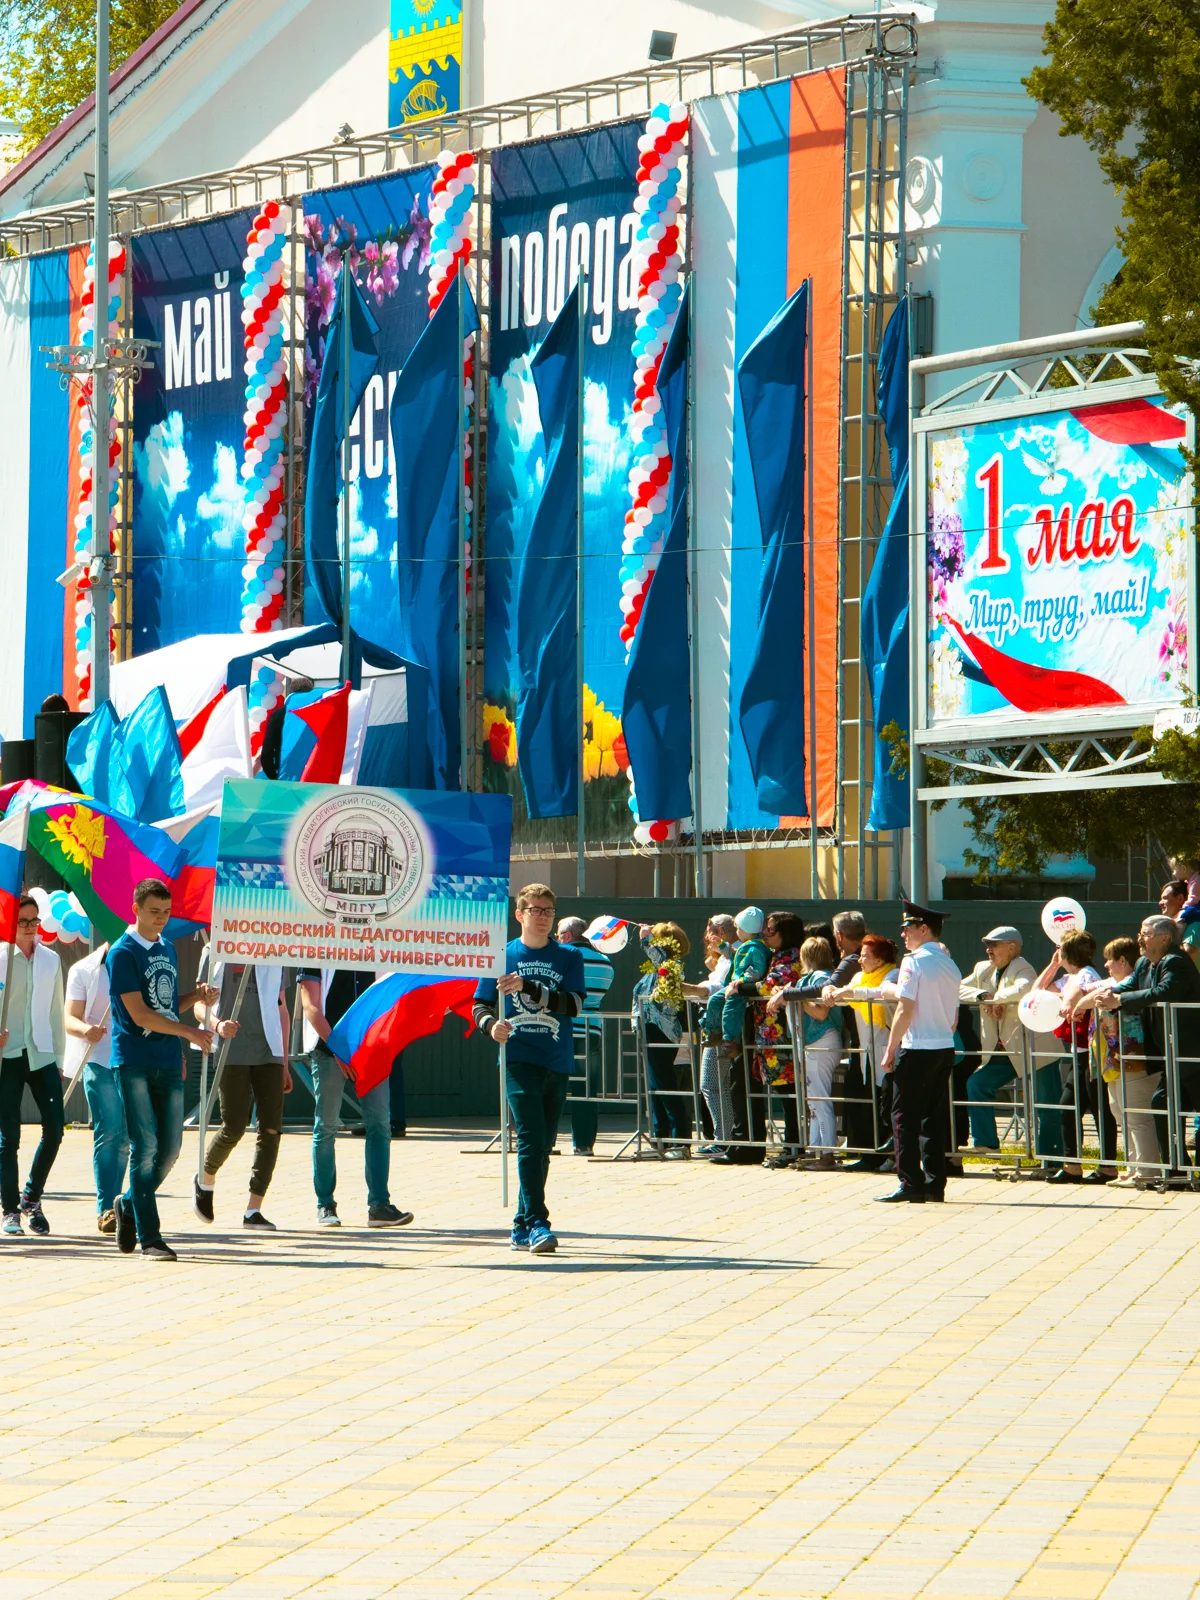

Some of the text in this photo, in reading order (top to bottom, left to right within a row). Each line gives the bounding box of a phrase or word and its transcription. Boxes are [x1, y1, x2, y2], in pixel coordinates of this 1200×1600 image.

[164, 270, 232, 391] май
[979, 459, 1141, 570] 1 мая
[964, 574, 1148, 643] Мир, труд, май!
[299, 797, 420, 908] МОСКОВСКИЙ ПЕДАГОГИЧЕСКИЙ ГОСУДАРСТВЕННЫЙ УНИВЕРСИТЕТ
[336, 900, 377, 914] МПГУ
[216, 940, 496, 969] ГОСУДАРСТВЕННЫЙ УНИВЕРСИТЕТ
[223, 919, 490, 947] МОСКОВСКИЙ ПЕДАГОГИЧЕСКИЙ
[517, 960, 552, 969] Московский
